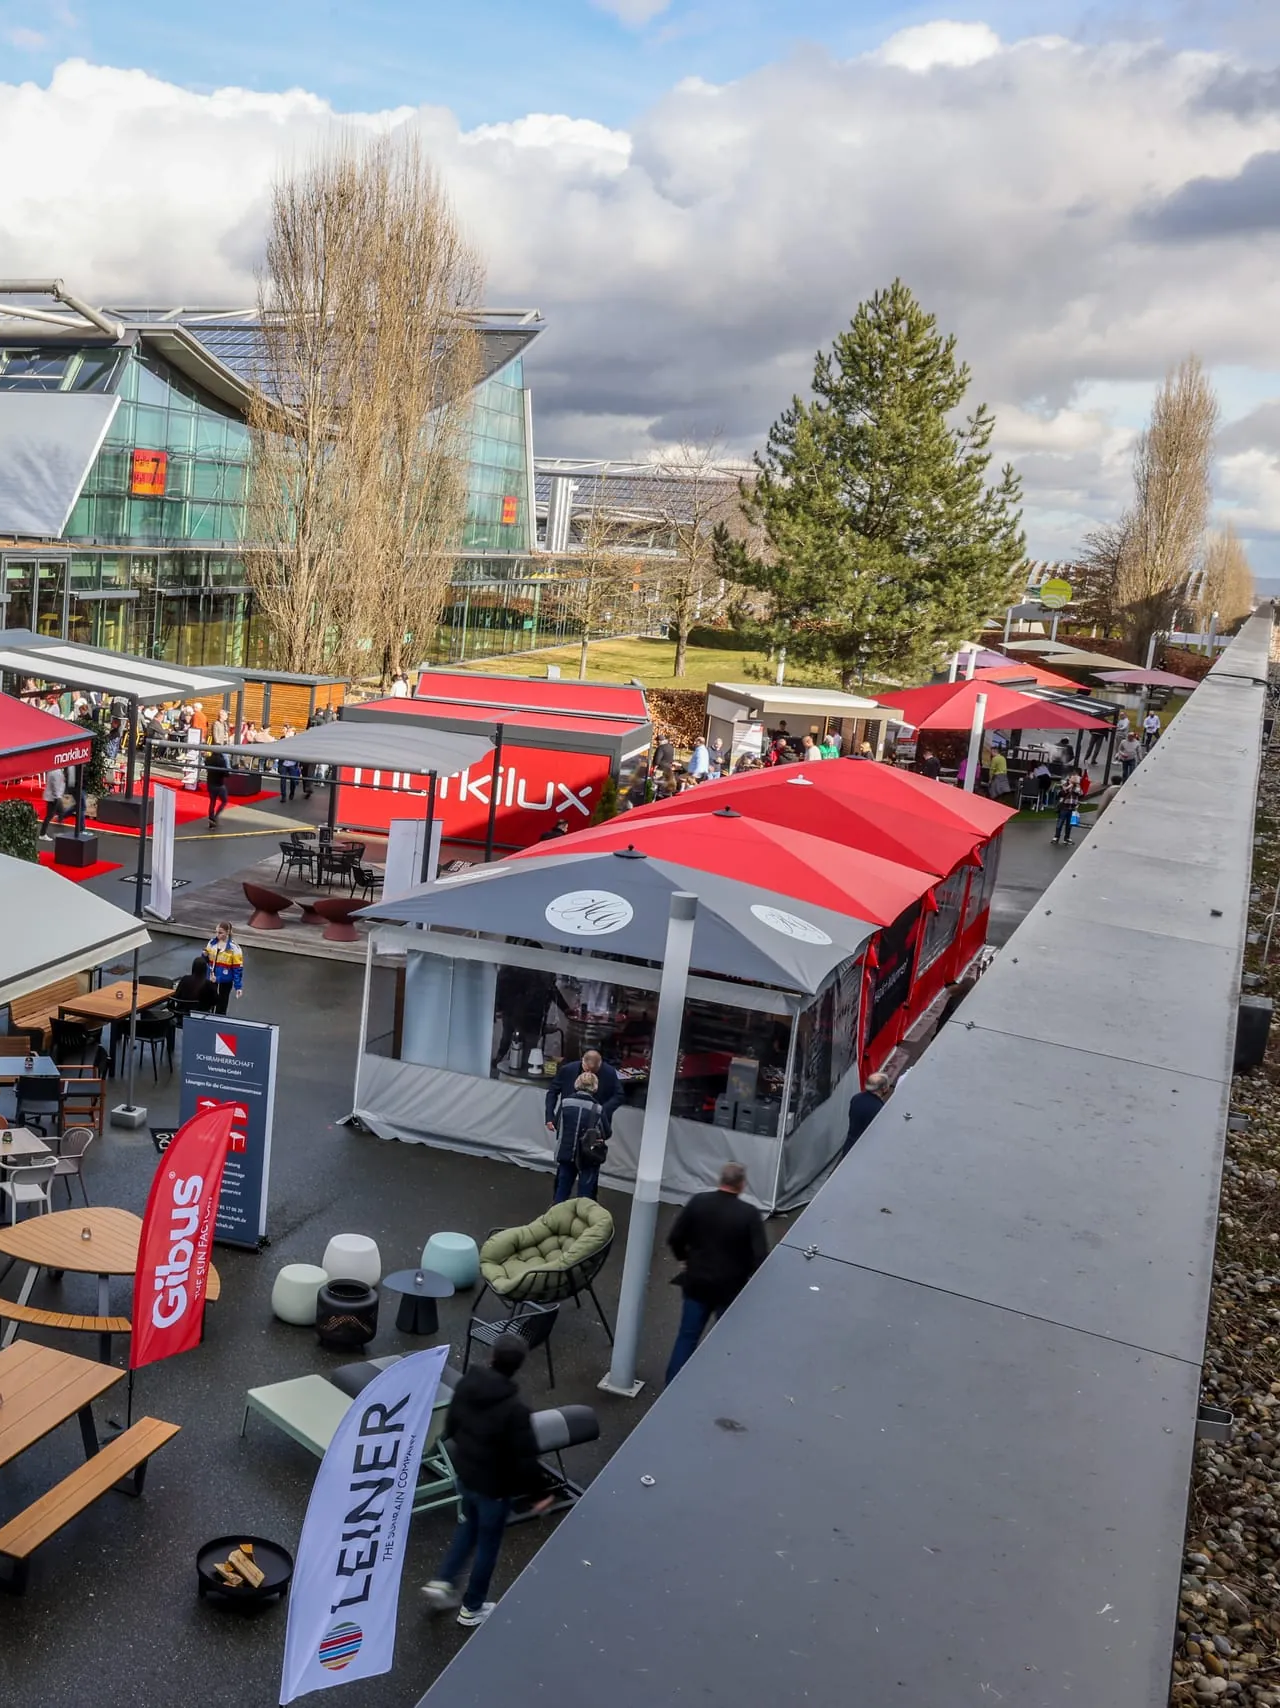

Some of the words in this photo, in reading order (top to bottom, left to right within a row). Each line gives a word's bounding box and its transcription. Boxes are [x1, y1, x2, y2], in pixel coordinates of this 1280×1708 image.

[151, 457, 160, 486] 7
[54, 747, 89, 765] markilux
[196, 1053, 254, 1068] SCHIRMHERRSCHAFT
[152, 1175, 204, 1329] Gibus
[196, 1252, 206, 1277] SUN
[331, 1392, 411, 1614] LEINER
[382, 1541, 394, 1562] THE
